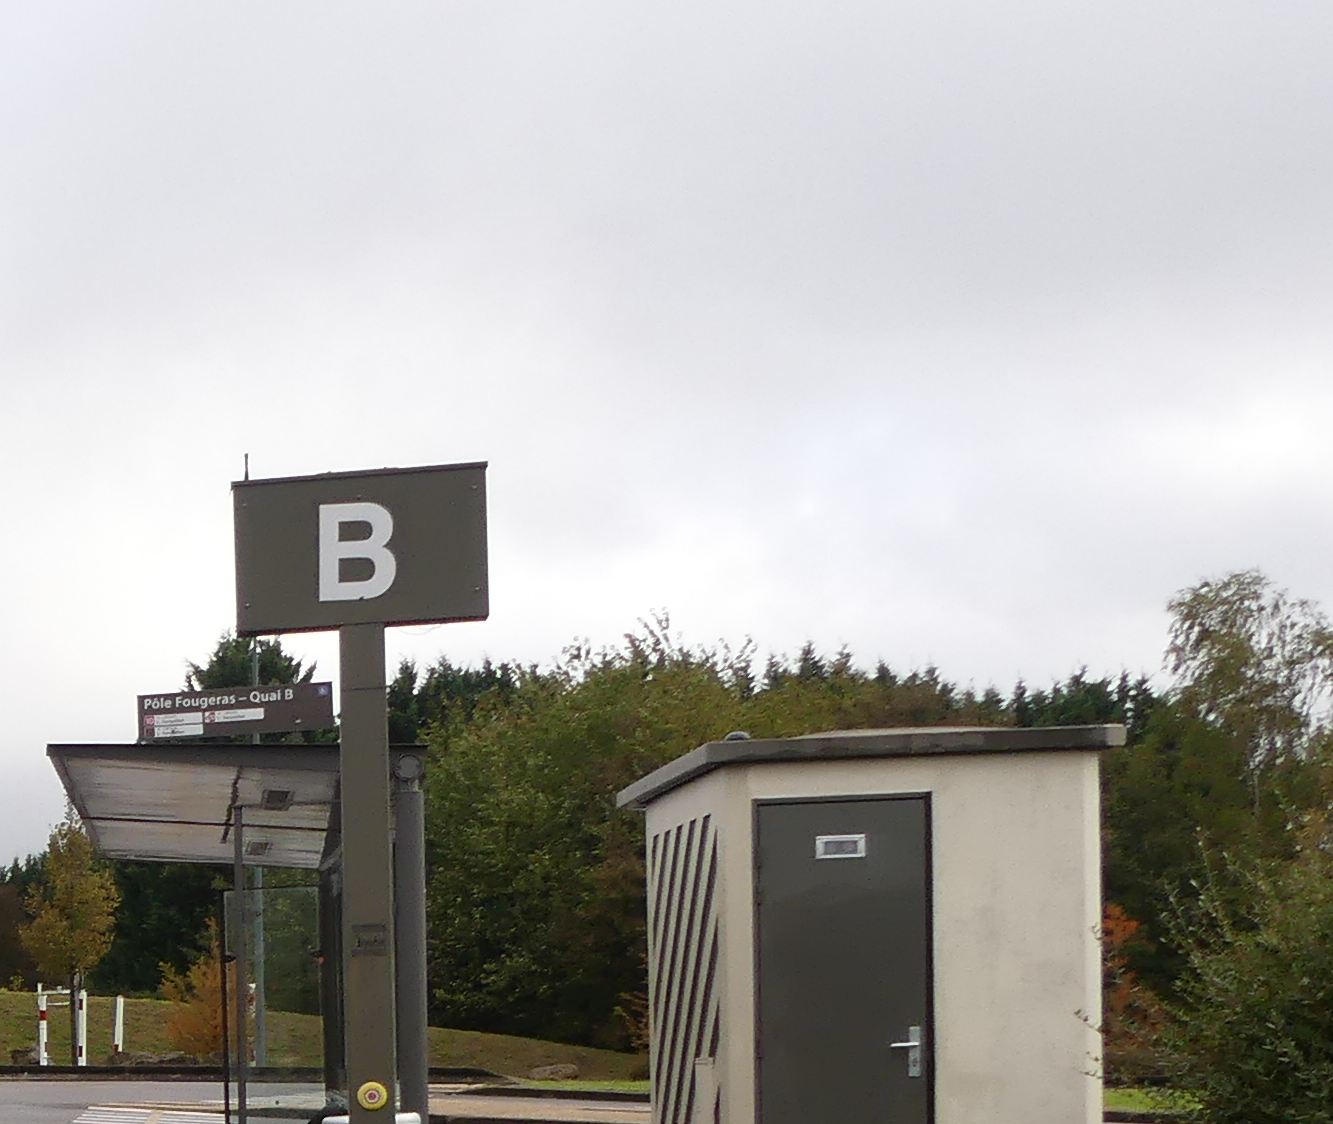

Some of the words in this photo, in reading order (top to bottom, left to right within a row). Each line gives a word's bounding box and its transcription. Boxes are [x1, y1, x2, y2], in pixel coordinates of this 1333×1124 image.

[318, 502, 397, 601] B
[143, 697, 172, 710] Pôle
[175, 694, 236, 709] Fougeras
[249, 689, 281, 703] Quai
[284, 689, 294, 701] B
